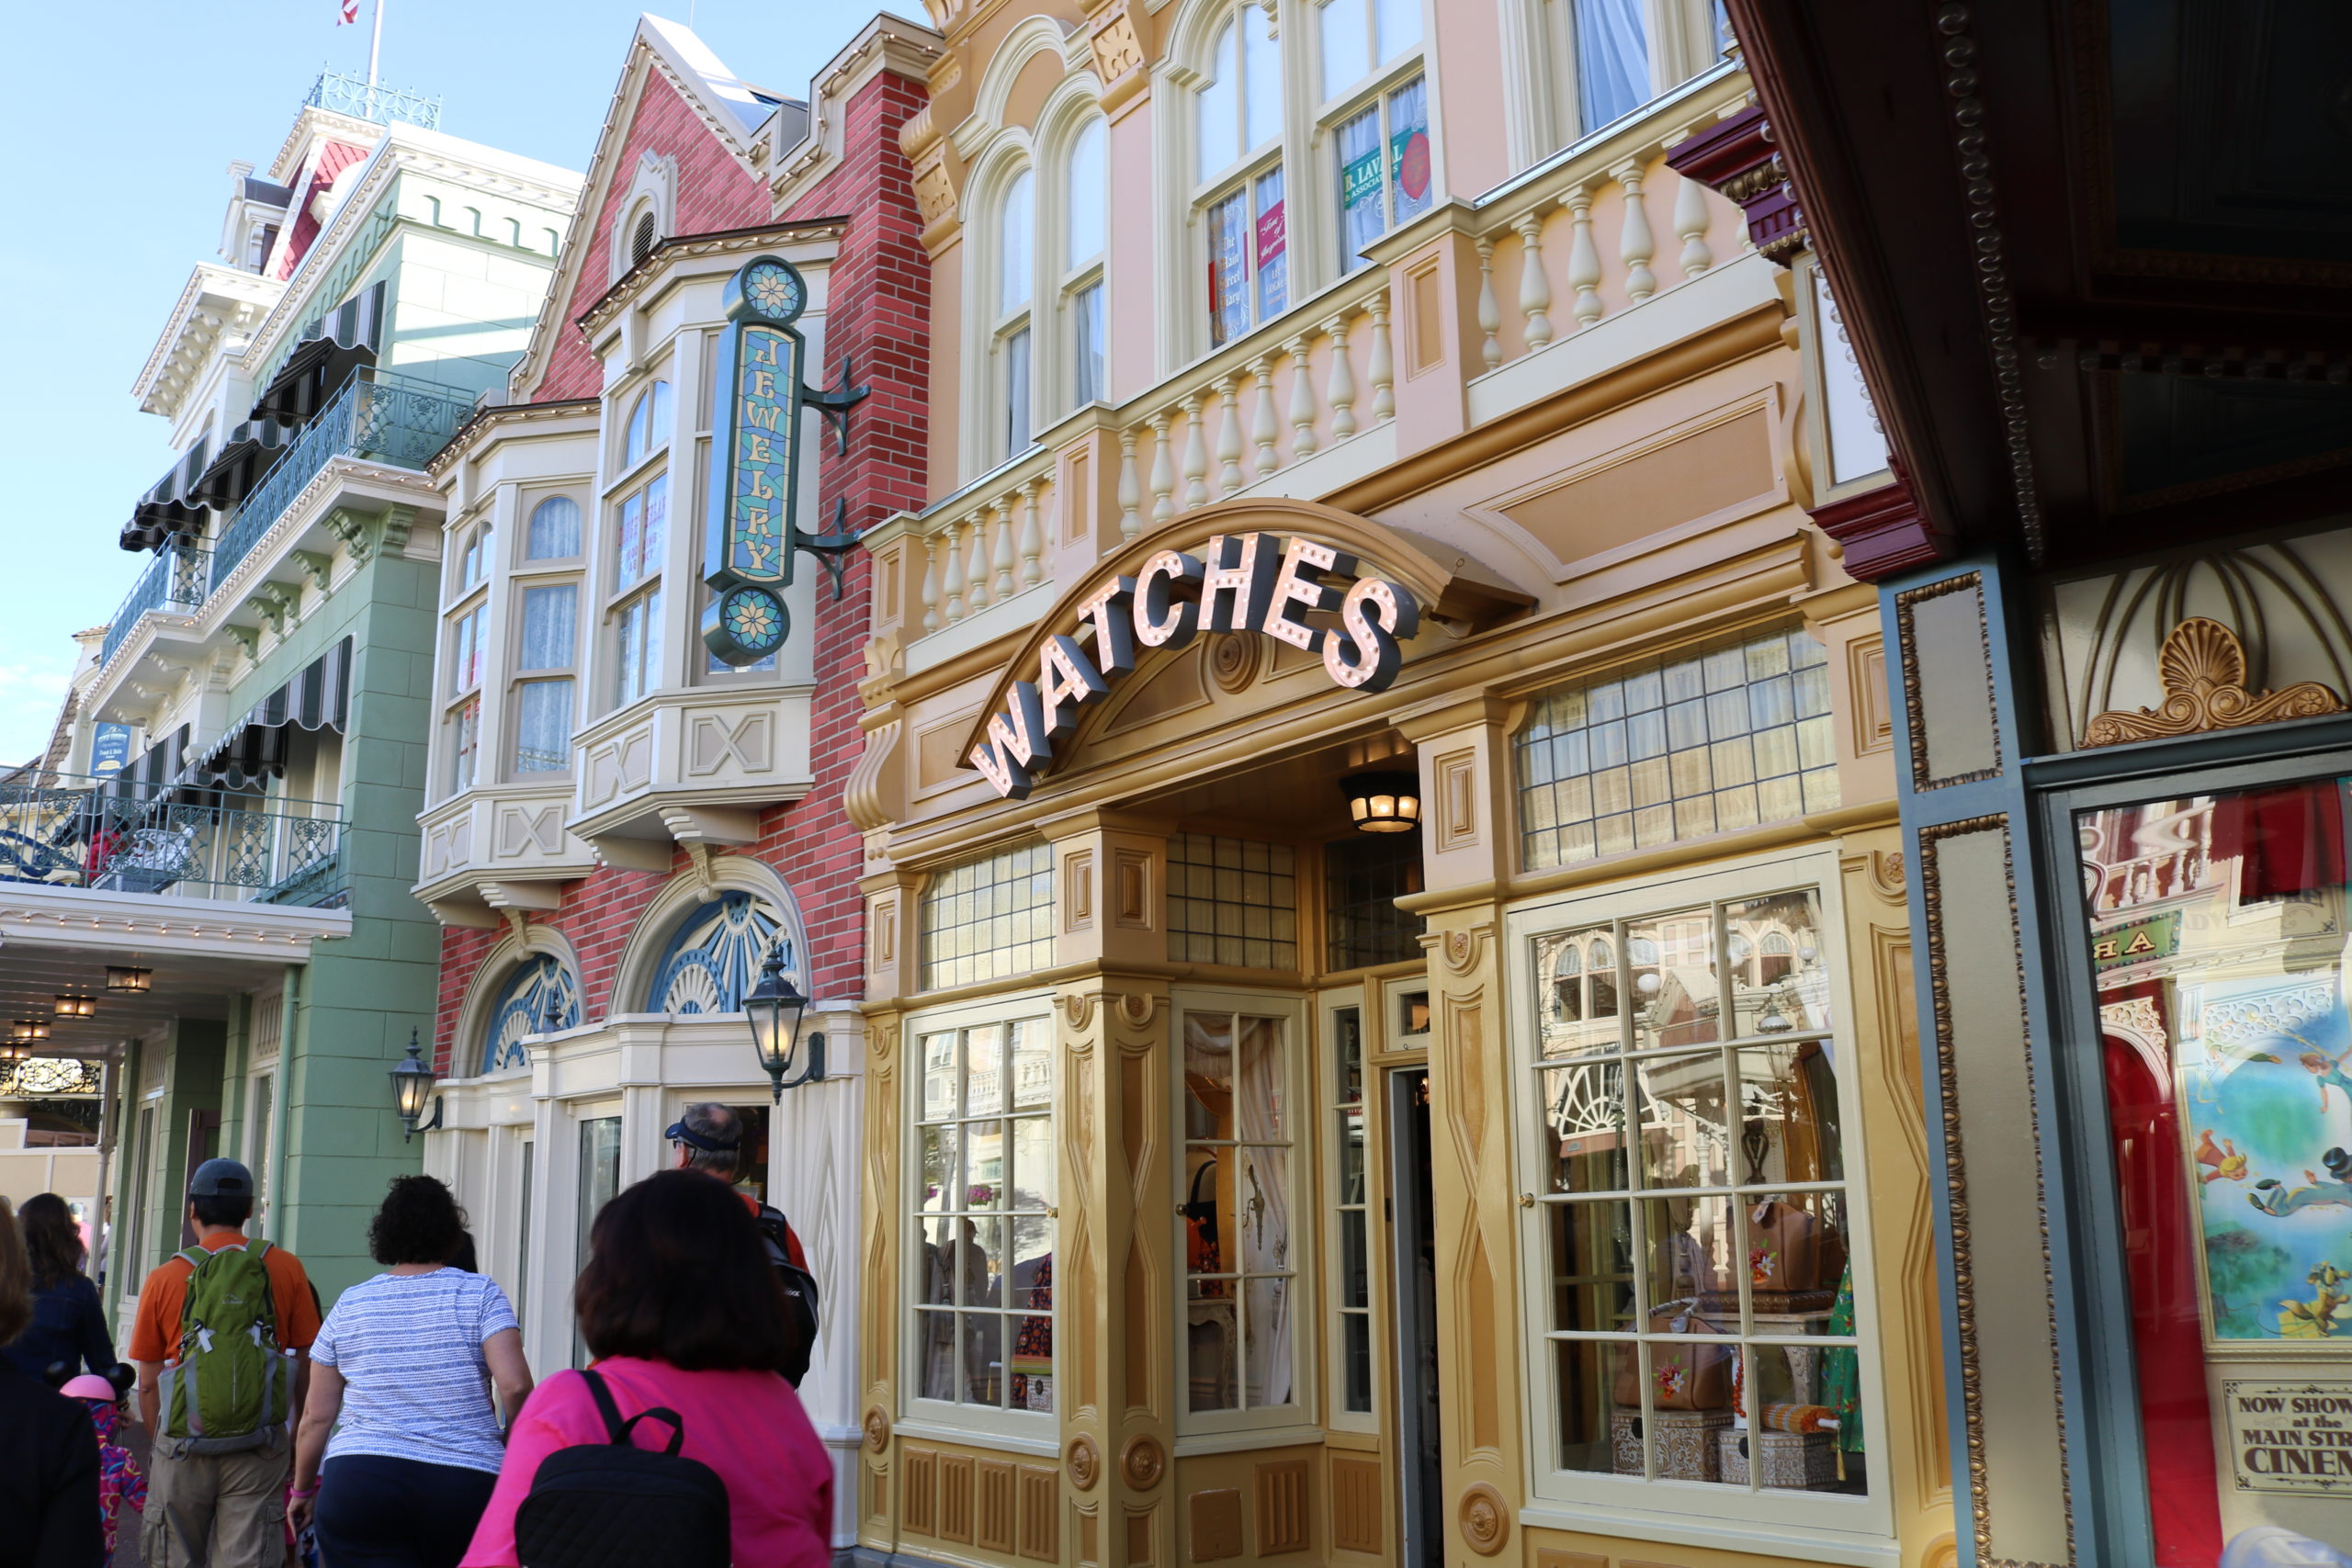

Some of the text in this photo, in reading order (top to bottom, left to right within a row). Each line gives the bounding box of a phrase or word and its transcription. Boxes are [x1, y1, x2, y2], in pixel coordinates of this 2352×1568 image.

[1344, 175, 1356, 193] B.
[1358, 144, 1403, 185] LAVL
[745, 338, 781, 570] JEWELRY
[968, 532, 1418, 800] WATCHES
[2238, 1396, 2352, 1415] NOW SHOW
[2292, 1415, 2343, 1428] at the
[2243, 1429, 2303, 1446] MAIN
